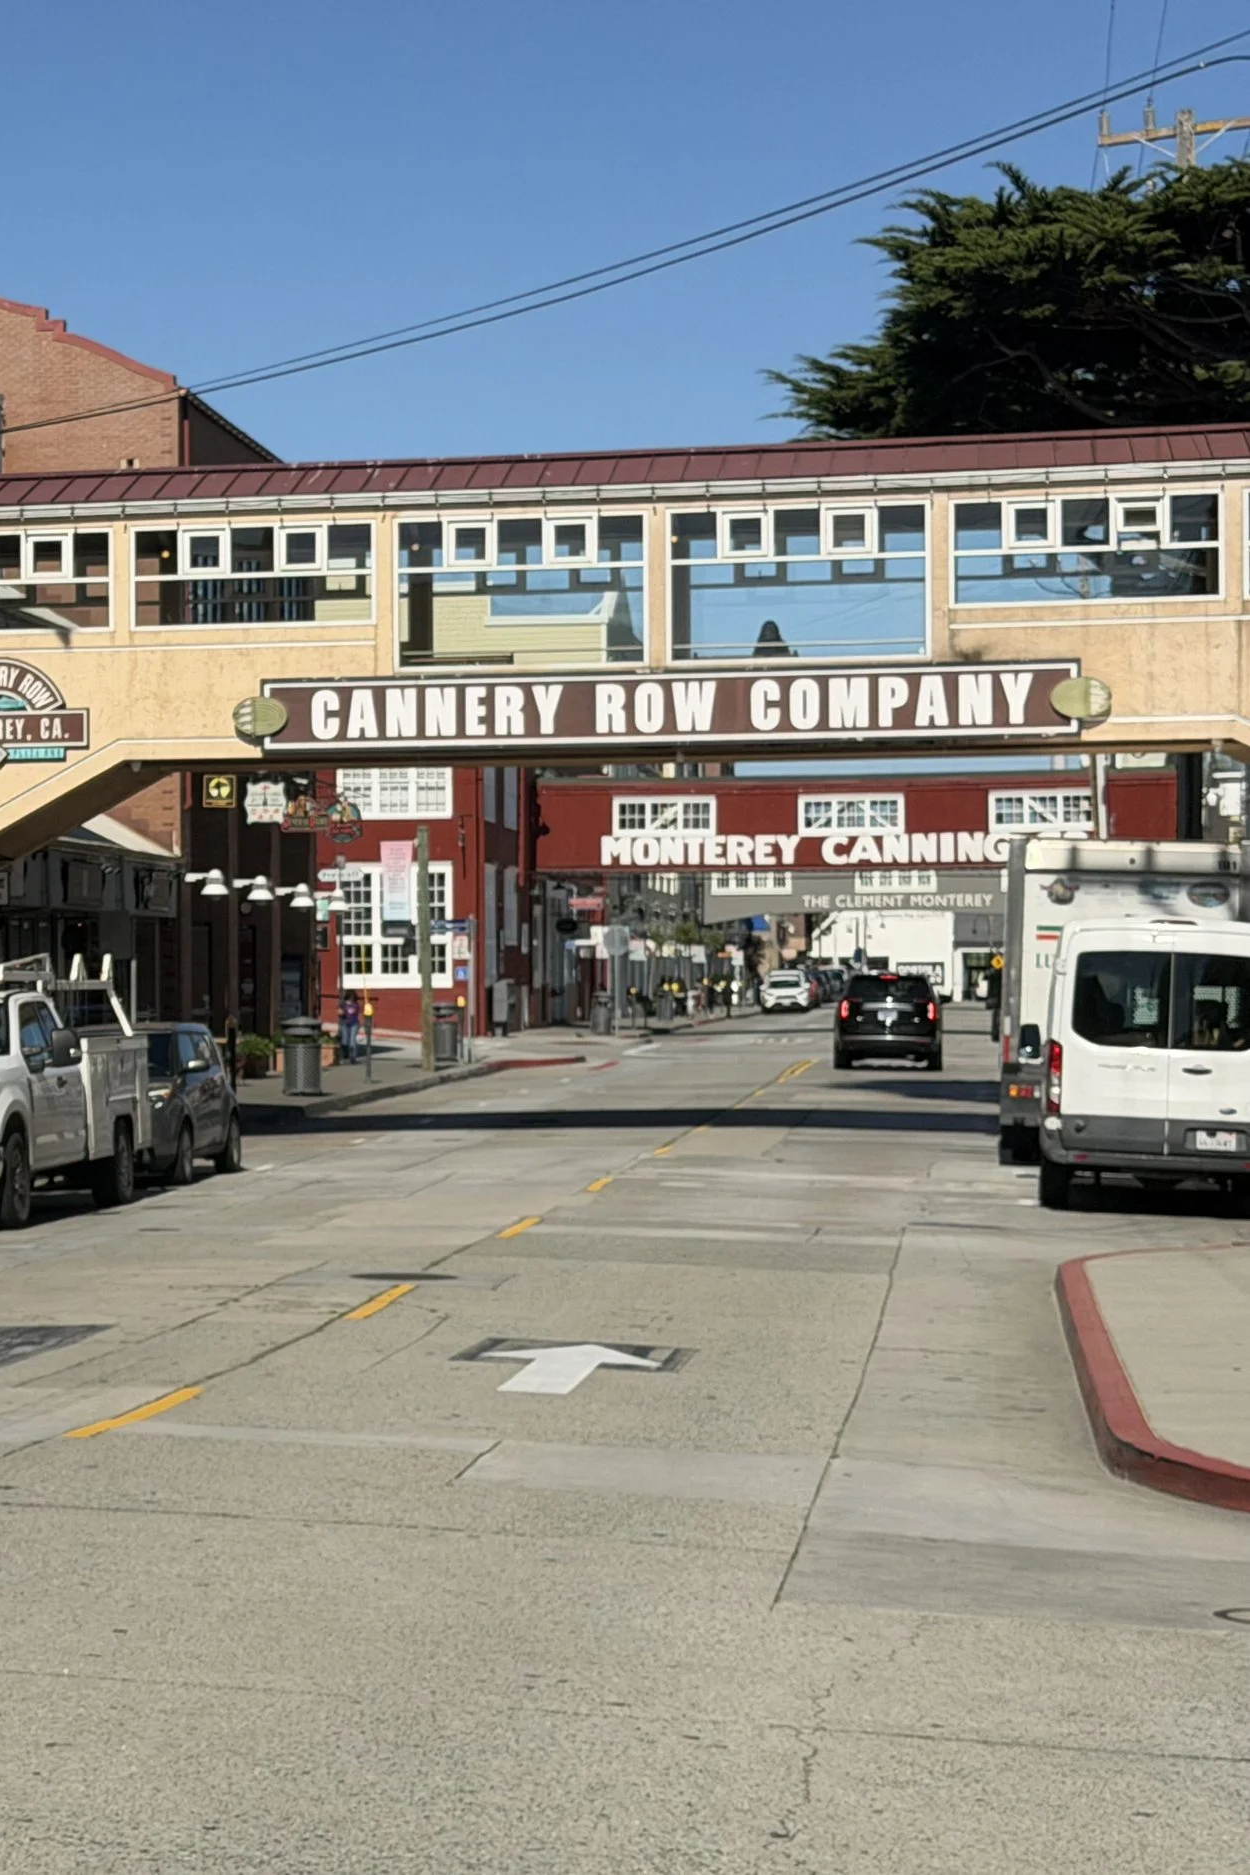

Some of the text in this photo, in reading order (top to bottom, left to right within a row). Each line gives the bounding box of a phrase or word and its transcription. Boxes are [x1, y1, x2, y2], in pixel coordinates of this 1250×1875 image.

[17, 673, 54, 709] ROW
[310, 673, 1035, 740] CANNERY ROW COMPANY
[39, 717, 70, 740] CA.
[600, 831, 1011, 866] MONTEREY CANNING
[802, 893, 994, 908] THE CLEMENT MONTEREY
